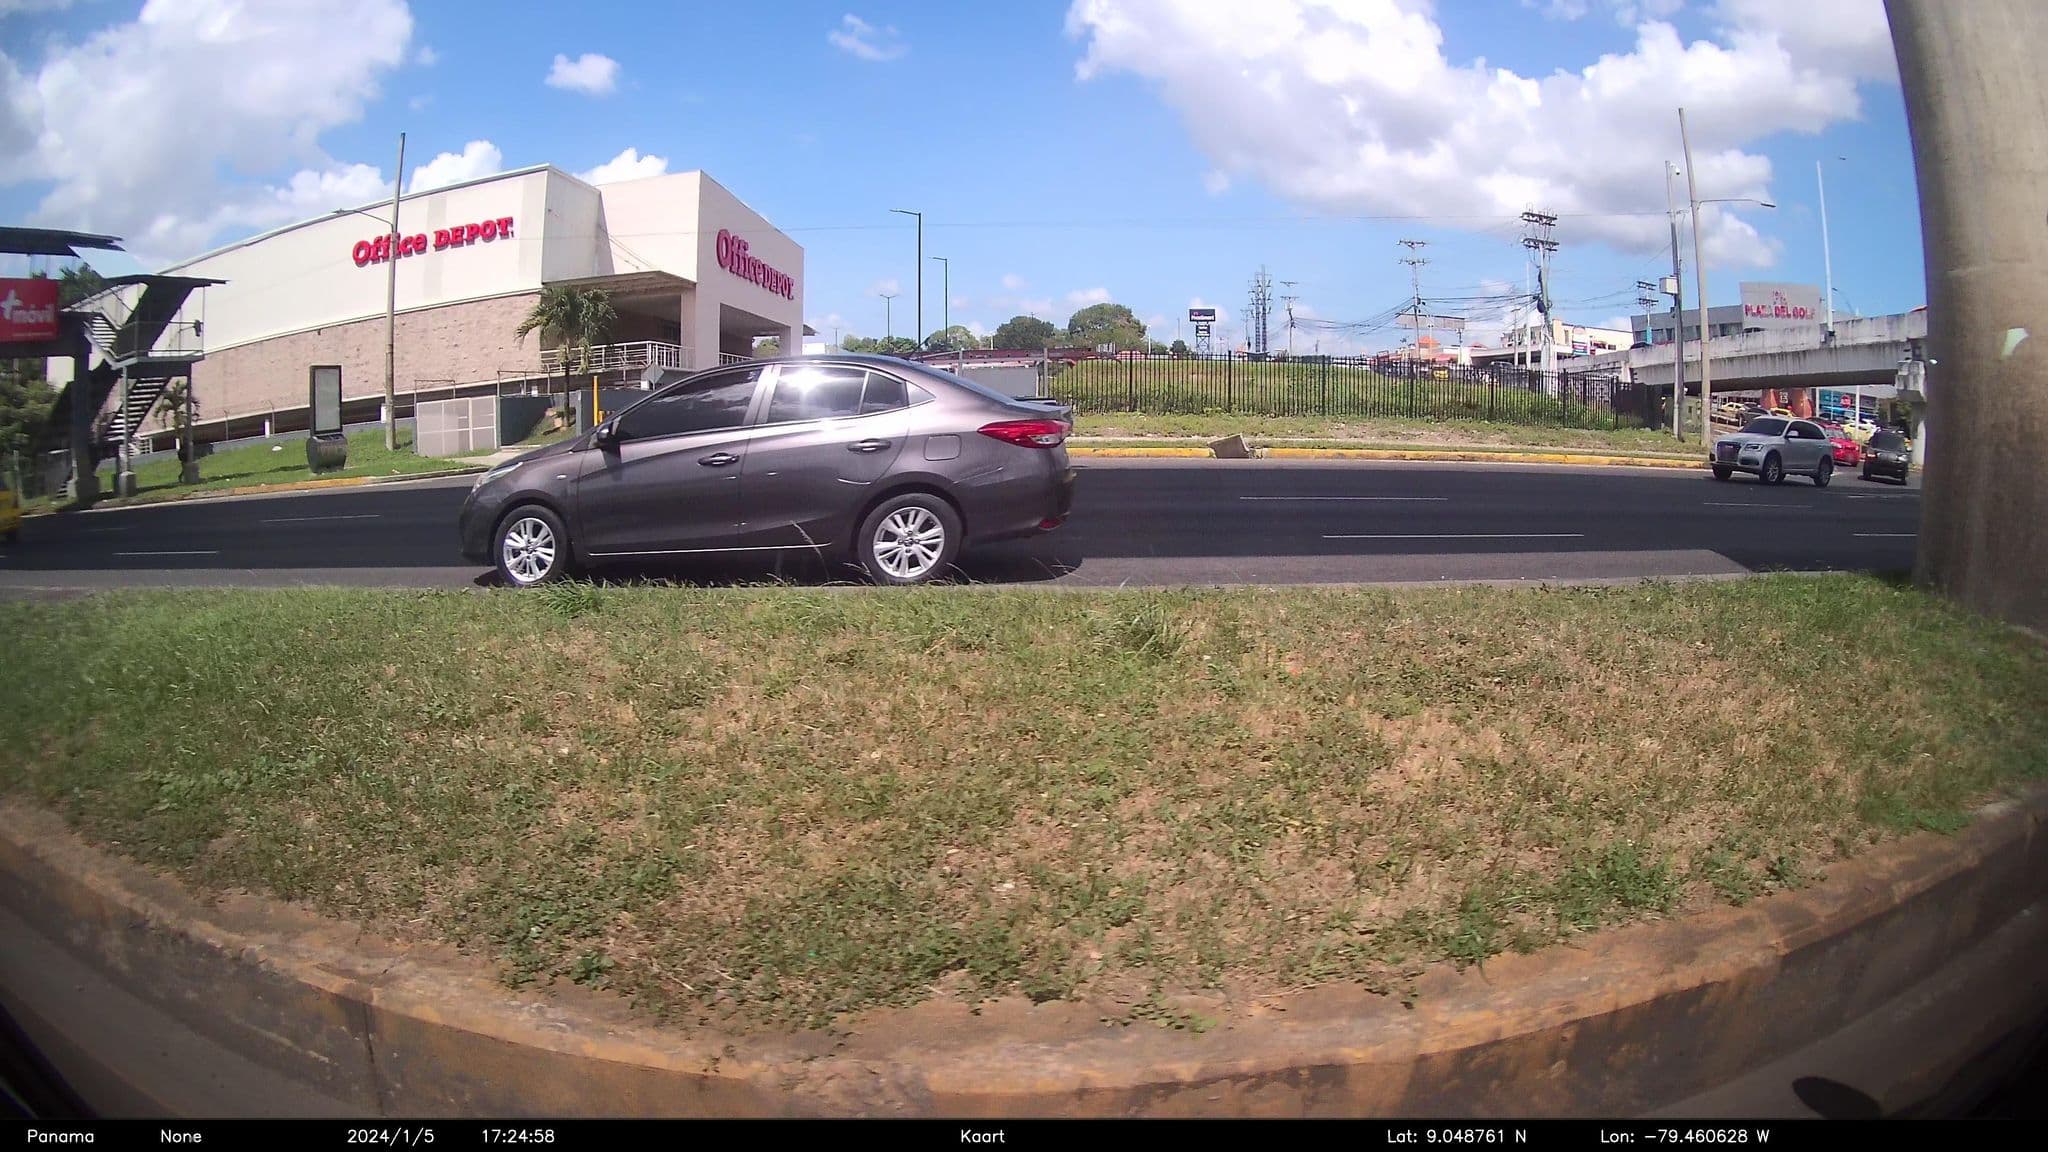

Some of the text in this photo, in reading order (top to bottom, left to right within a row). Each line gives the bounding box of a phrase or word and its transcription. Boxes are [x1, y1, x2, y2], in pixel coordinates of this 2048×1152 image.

[433, 217, 514, 251] DEPOT
[716, 228, 795, 301] Office DEPOT
[1774, 305, 1791, 319] DEL
